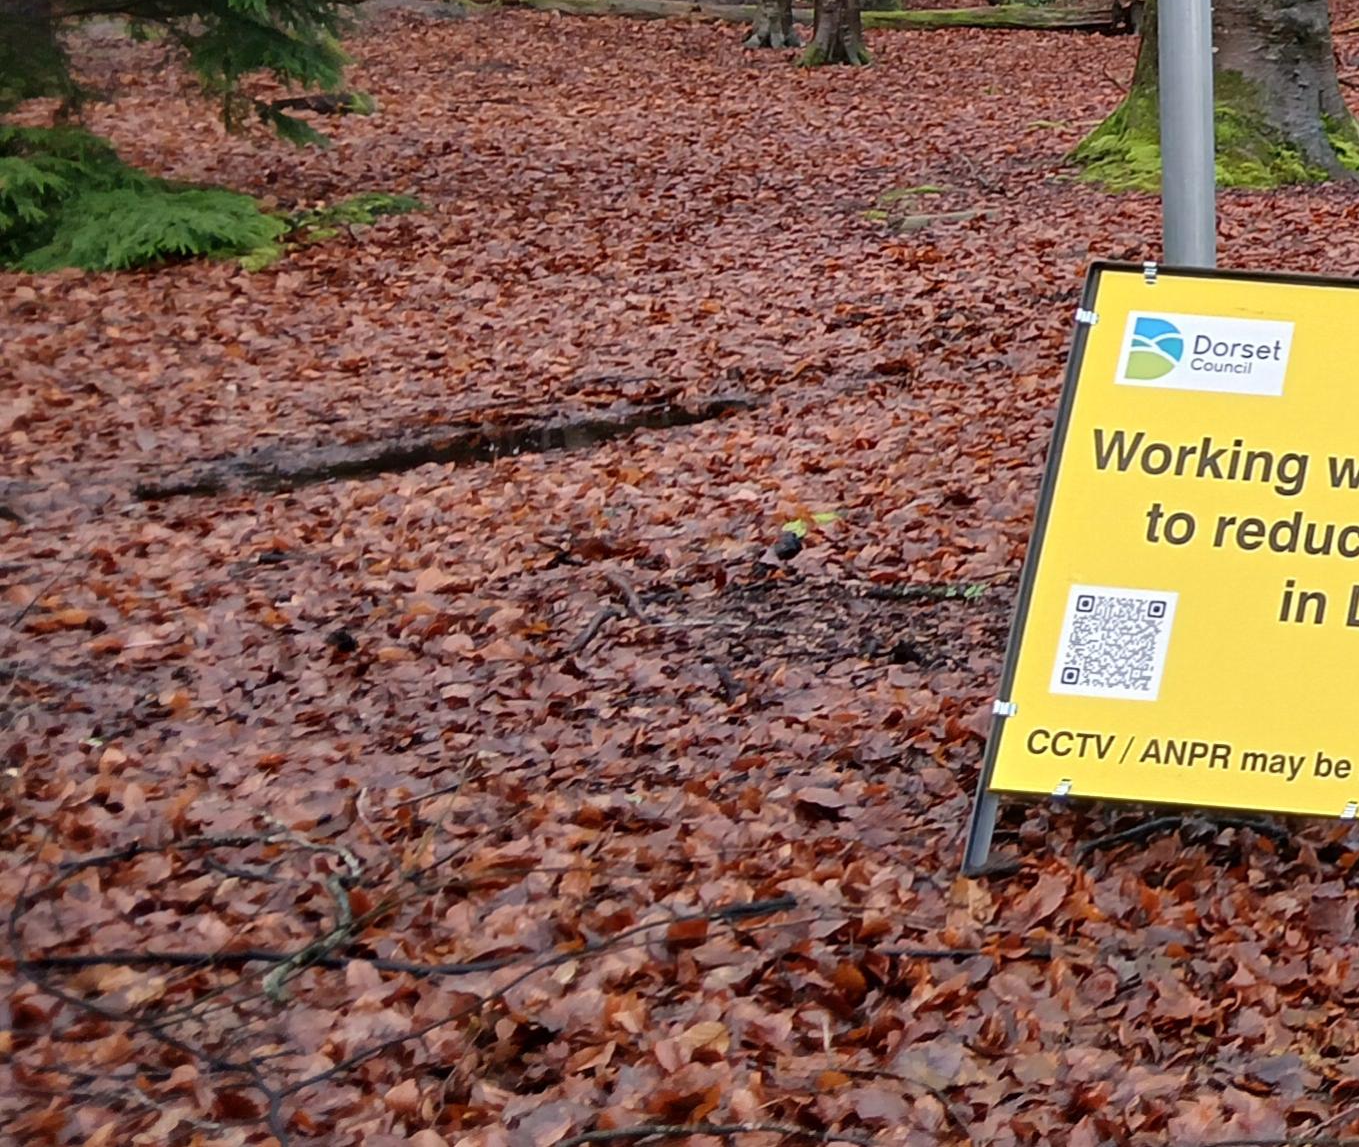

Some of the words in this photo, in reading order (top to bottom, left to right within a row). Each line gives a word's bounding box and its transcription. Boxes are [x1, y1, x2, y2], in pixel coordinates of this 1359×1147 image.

[1190, 357, 1254, 374] Council
[1192, 334, 1282, 361] Dorset
[1093, 428, 1309, 497] Working
[1146, 503, 1196, 546] to
[1279, 579, 1327, 625] in
[1027, 728, 1118, 761] CCTV
[1118, 735, 1134, 764] /
[1139, 739, 1232, 770] ANPR
[1240, 751, 1307, 783] may
[1313, 751, 1352, 779] be
